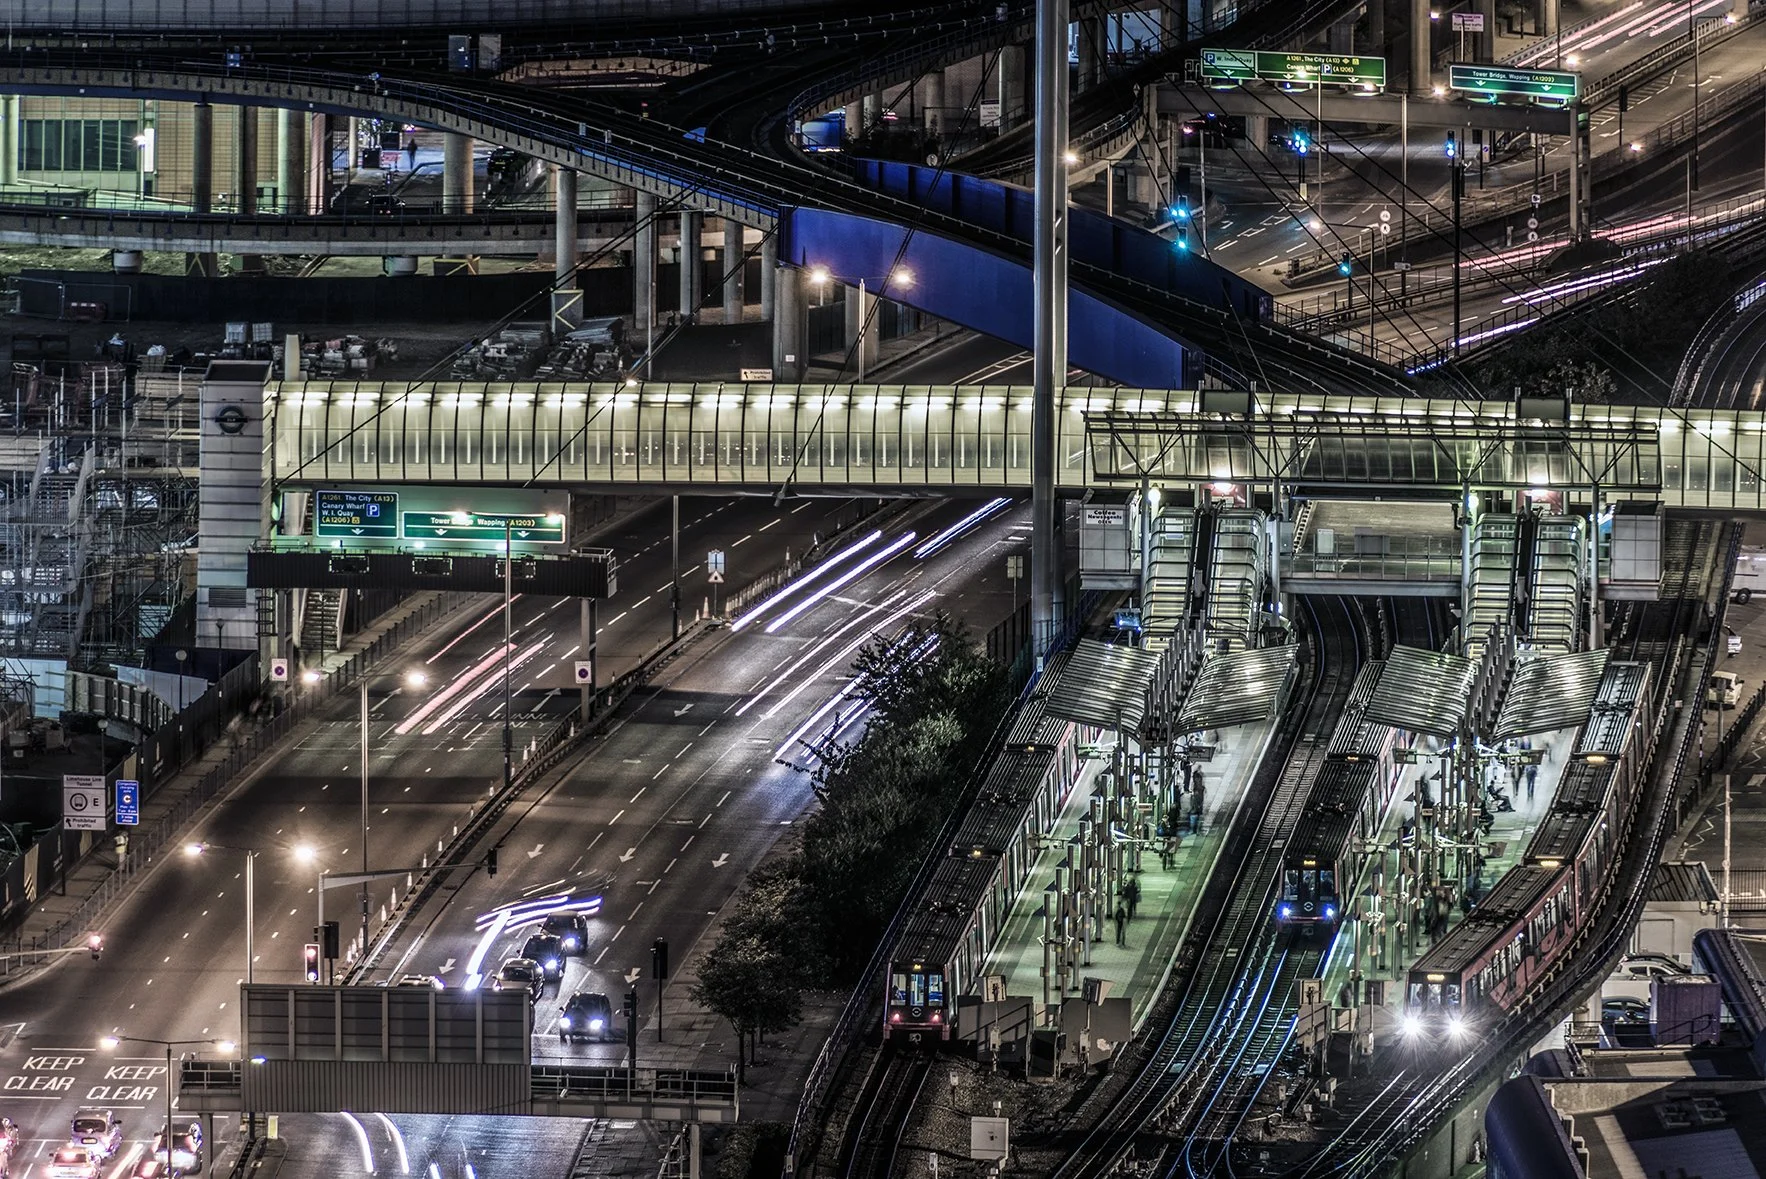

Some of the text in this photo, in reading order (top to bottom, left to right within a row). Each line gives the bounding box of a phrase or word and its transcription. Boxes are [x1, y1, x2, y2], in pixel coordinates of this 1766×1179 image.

[370, 506, 378, 515] P
[477, 518, 506, 526] Wapping
[93, 798, 100, 806] E
[22, 1056, 85, 1070] KEEP
[104, 1066, 168, 1080] KEEP
[4, 1076, 76, 1090] CLEAR
[86, 1086, 158, 1100] CLEAR
